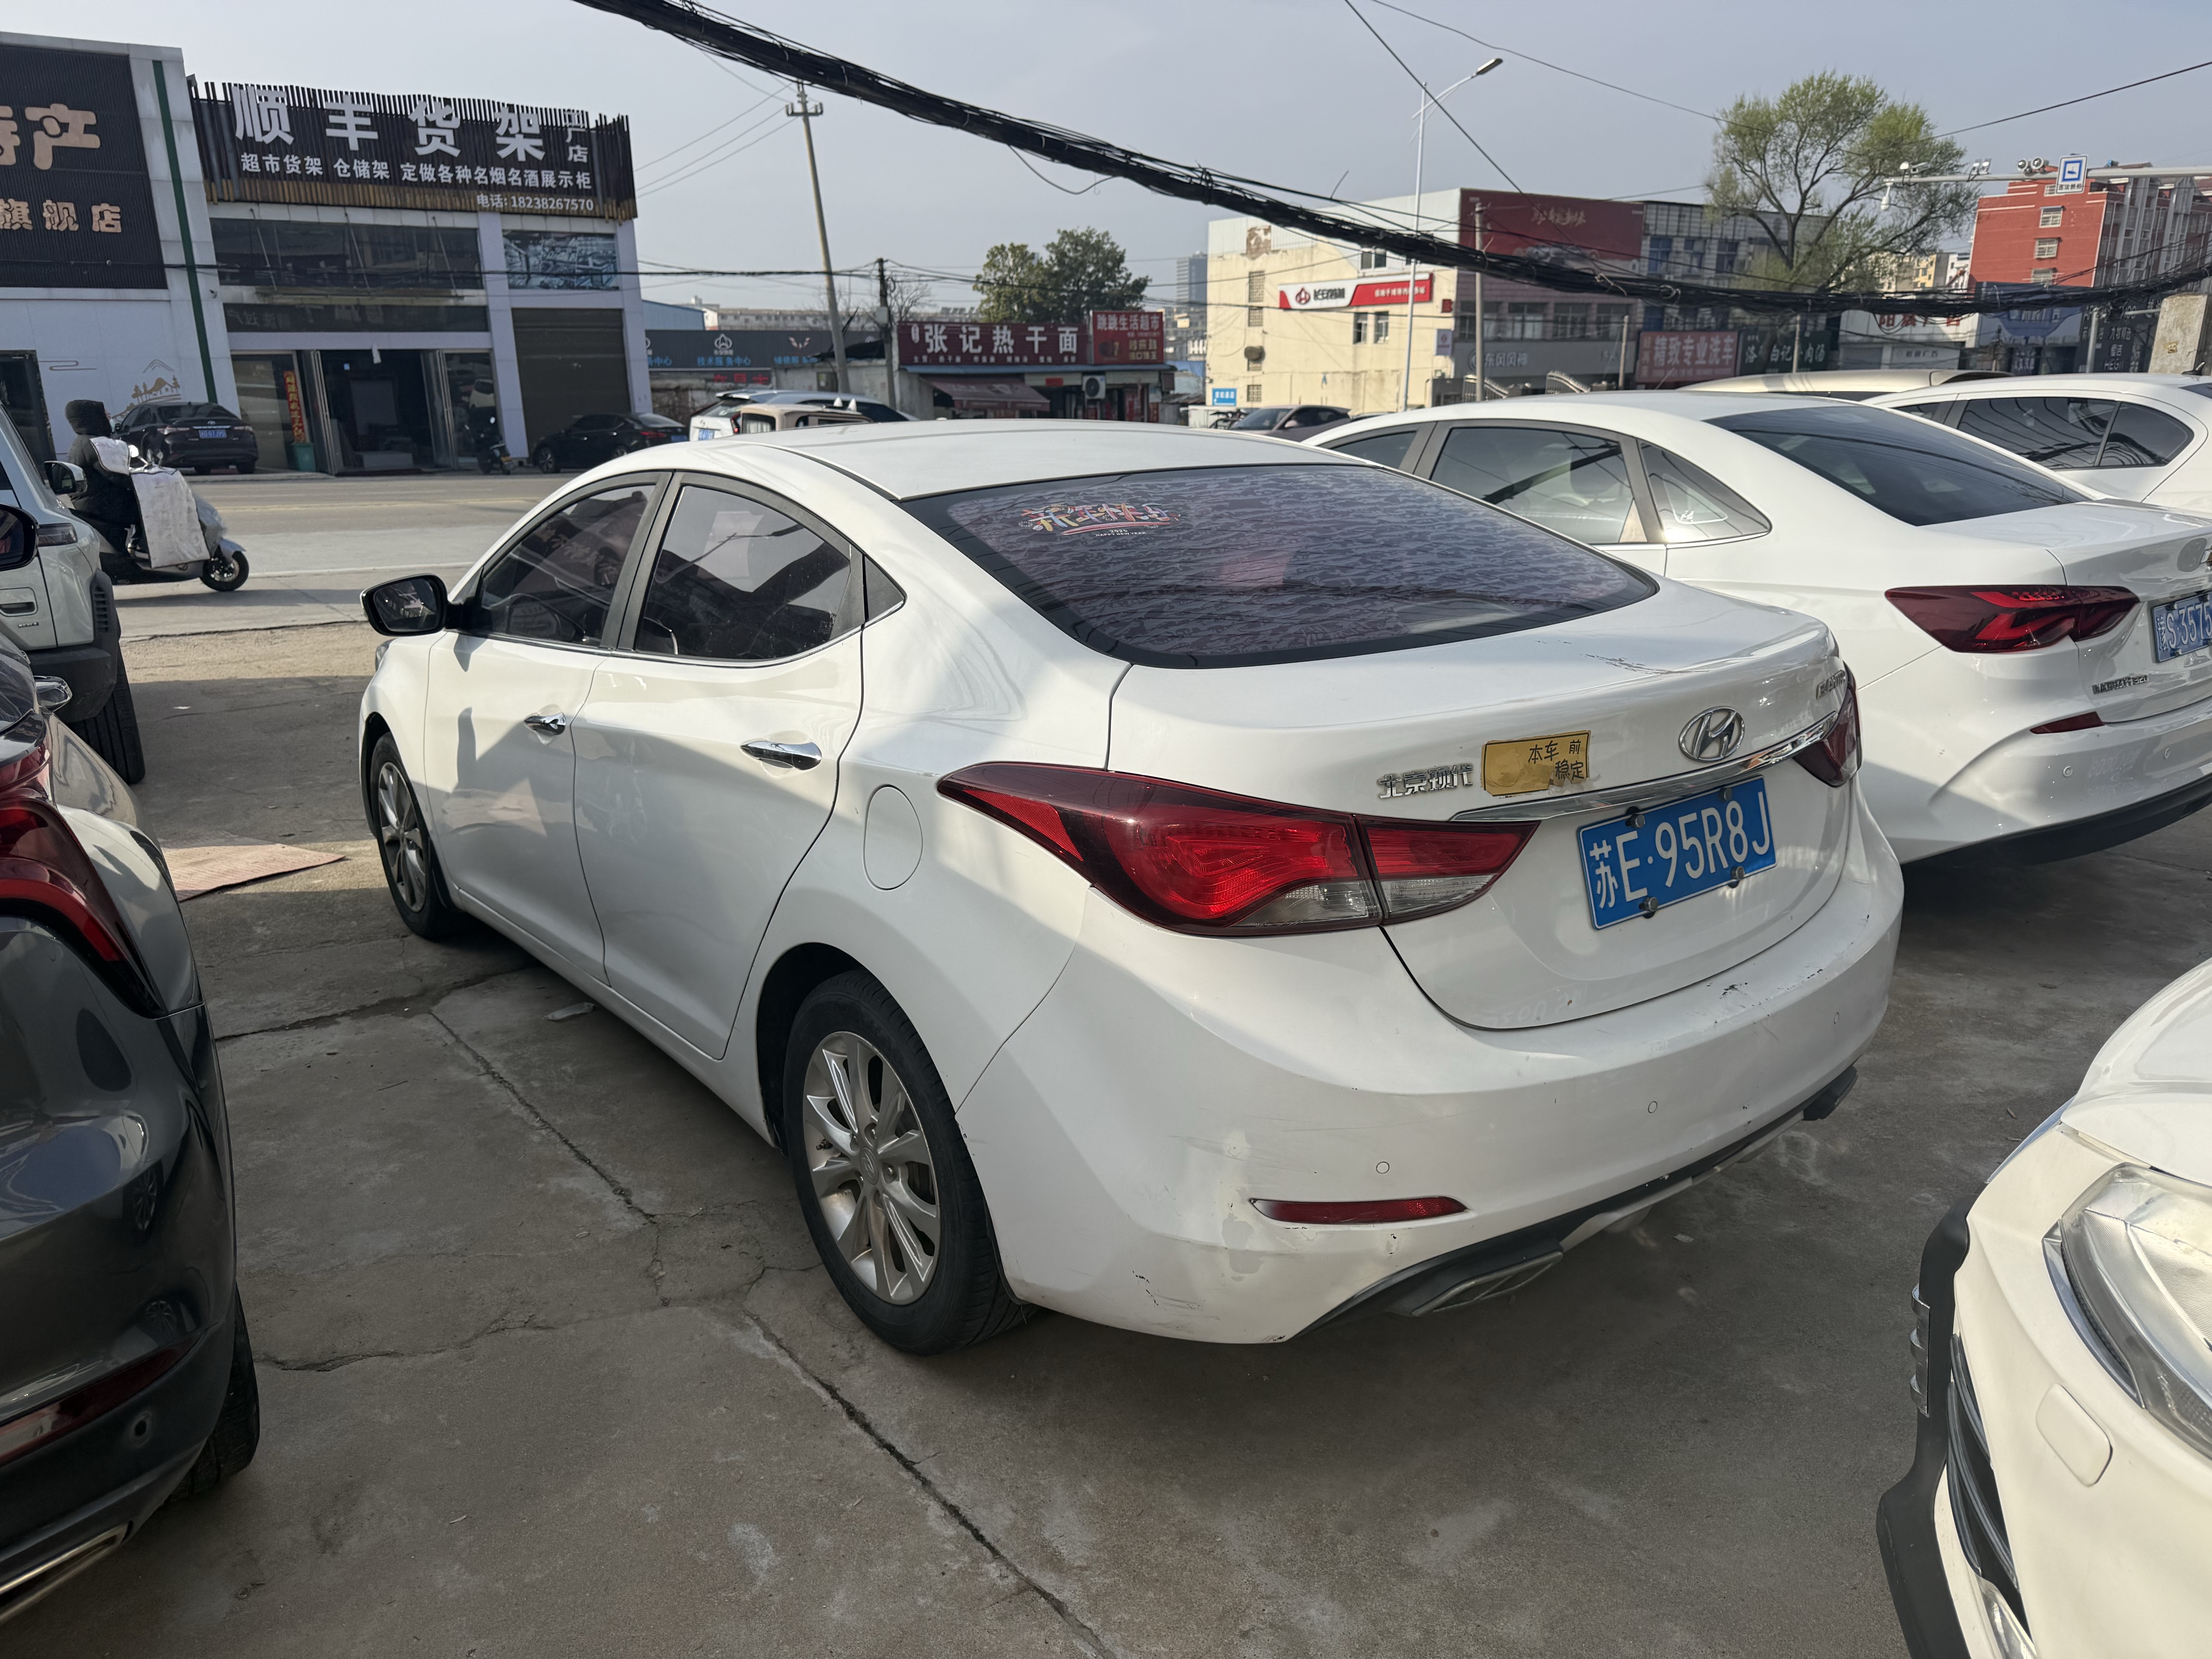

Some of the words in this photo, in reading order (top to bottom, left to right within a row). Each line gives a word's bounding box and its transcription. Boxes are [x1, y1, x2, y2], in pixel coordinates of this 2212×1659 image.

[231, 85, 546, 161] 顺丰货架
[564, 111, 588, 163] 工厂店
[241, 152, 323, 175] 超市货架
[333, 158, 390, 179] 仓储架
[400, 162, 592, 189] 定做各种名烟名酒展示柜
[0, 198, 122, 233] 旗舰店
[511, 196, 594, 211] 18238267570
[924, 324, 1079, 354] 张记热干面
[1484, 352, 1528, 367] 东风风神
[1528, 740, 1559, 764] 本车
[1569, 739, 1581, 755] 前
[1378, 763, 1474, 799] 北京现代
[1554, 760, 1585, 781] 稳定
[1589, 792, 1770, 909] 苏E·95R8J
